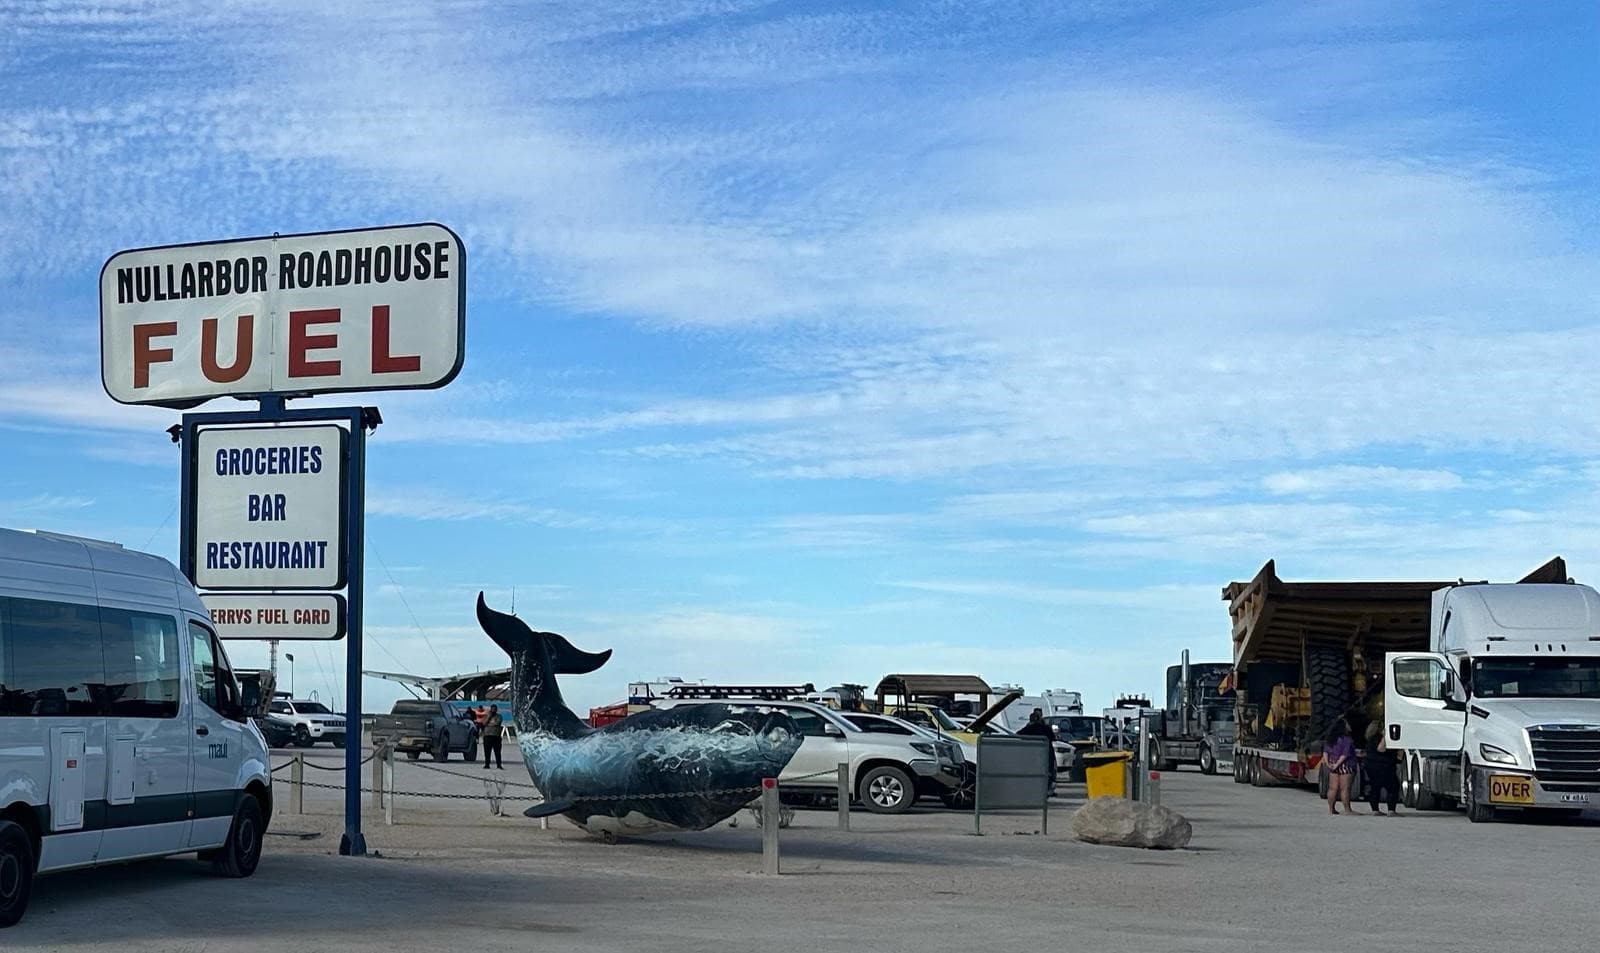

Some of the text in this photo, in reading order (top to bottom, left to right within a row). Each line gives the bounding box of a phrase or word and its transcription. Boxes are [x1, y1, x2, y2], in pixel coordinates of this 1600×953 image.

[117, 241, 450, 304] NULLARBOR ROADHOUSE
[133, 304, 421, 389] FUEL
[215, 445, 323, 476] GROCERIES
[248, 493, 287, 522] BAR
[206, 541, 328, 569] RESTAURANT
[207, 609, 331, 625] ERRYS FUEL CARD
[208, 738, 228, 759] maui
[1492, 782, 1531, 798] OVER
